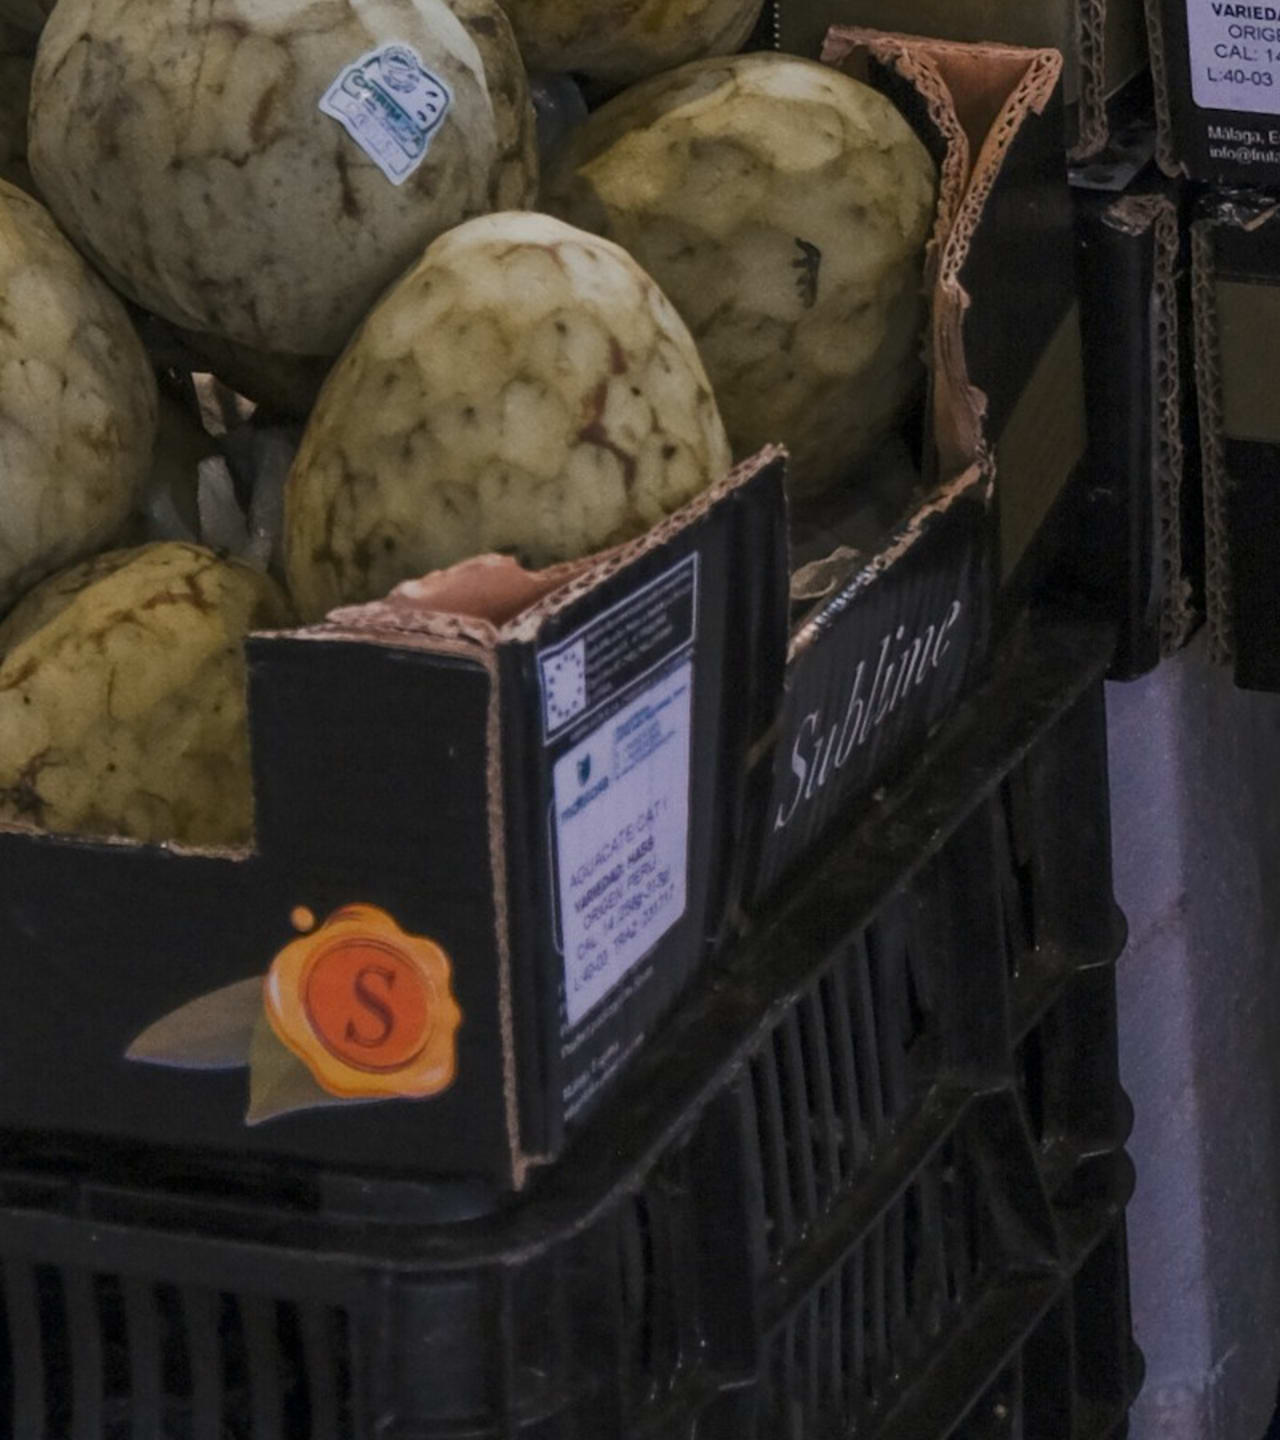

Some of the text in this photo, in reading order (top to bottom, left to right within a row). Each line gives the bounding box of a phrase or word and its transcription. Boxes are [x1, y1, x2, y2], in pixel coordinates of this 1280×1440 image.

[1214, 43, 1258, 62] CAL:
[773, 599, 961, 832] Sublime
[345, 963, 396, 1049] S
